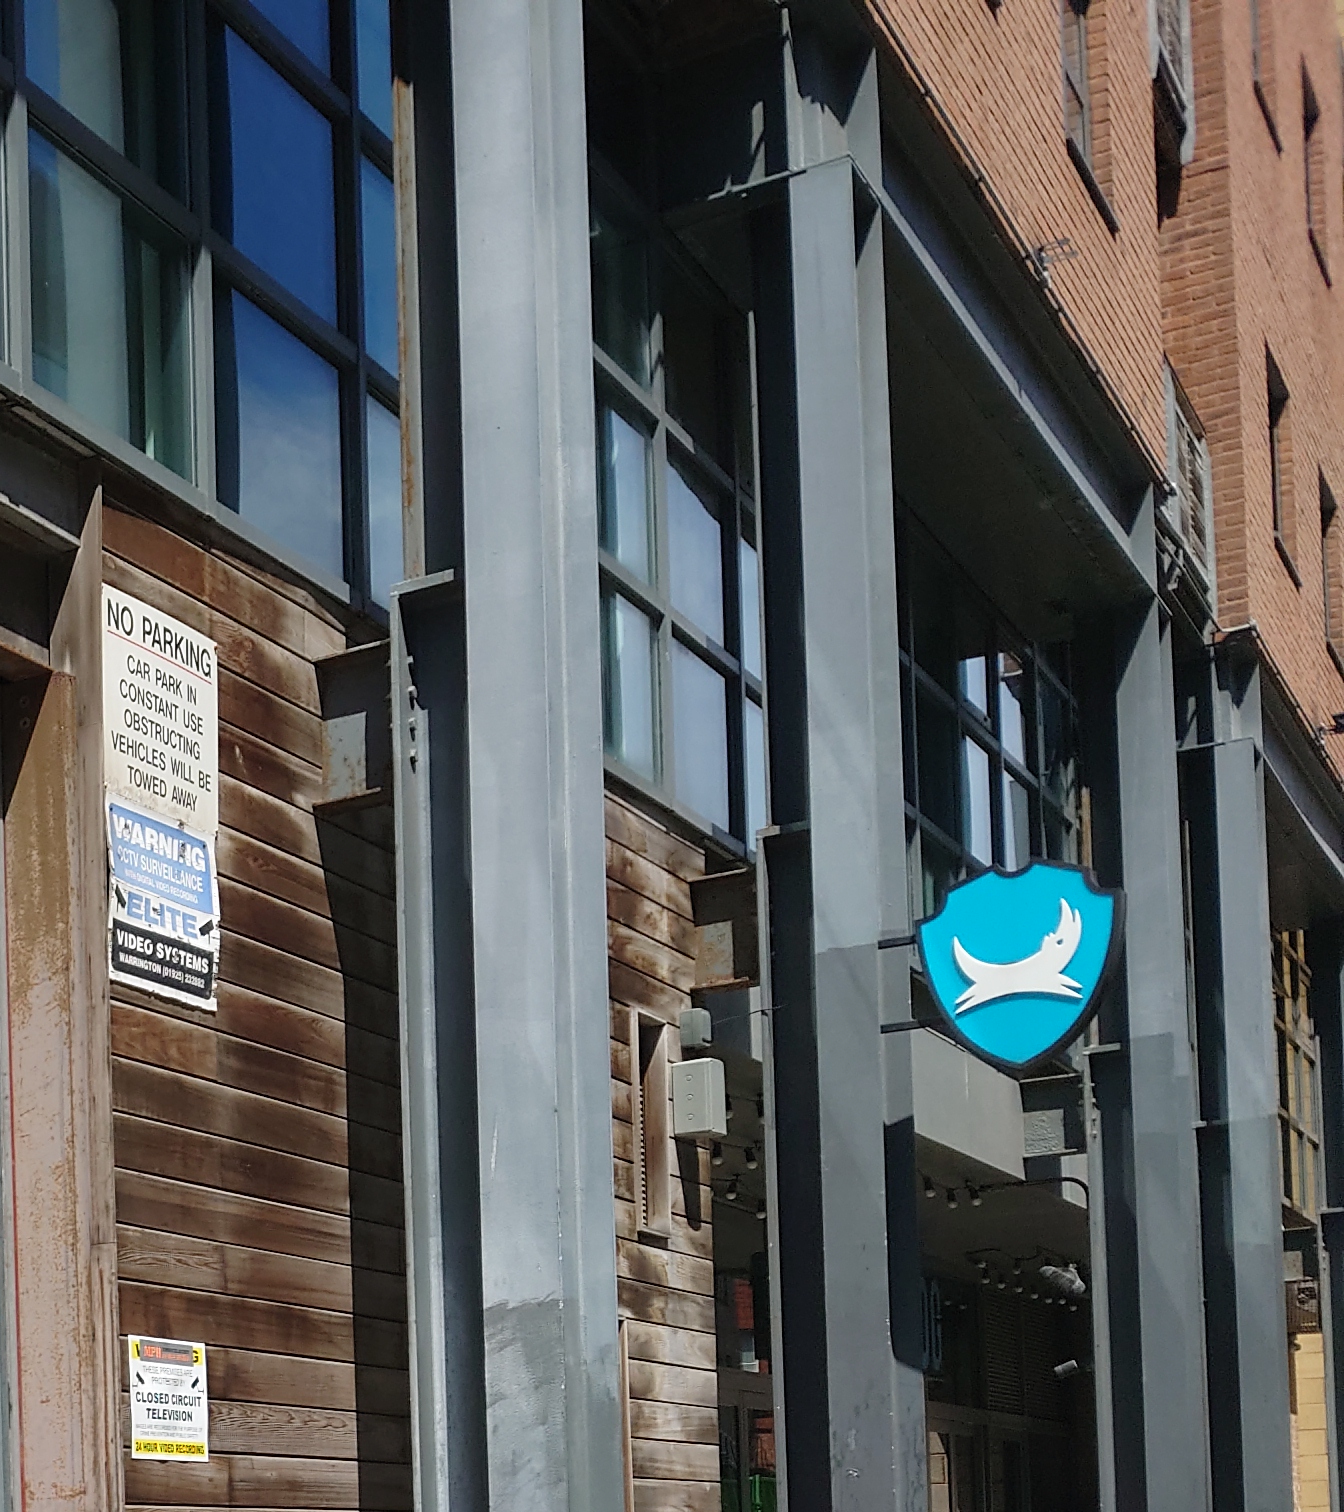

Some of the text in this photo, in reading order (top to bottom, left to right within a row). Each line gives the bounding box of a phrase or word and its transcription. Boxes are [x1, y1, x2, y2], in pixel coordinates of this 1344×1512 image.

[107, 598, 212, 678] NO PARKING
[127, 654, 197, 706] CAR PARK IN
[119, 679, 203, 736] CONSTANT USE
[123, 708, 200, 761] OBSTRUCTING
[111, 730, 211, 792] VEHICLES WILL BE
[127, 765, 198, 813] TOWED AWAY
[112, 813, 206, 872] WARNING
[117, 845, 204, 892] CCTV SURVEILLANCE
[155, 880, 170, 893] VIDEO
[126, 891, 198, 939] ELITE
[117, 929, 209, 974] VIDEO SYSTEMS
[119, 952, 162, 975] WARRINGTON
[135, 1391, 202, 1408] CLOSED CIRCUIT
[146, 1408, 193, 1422] TELEVISION
[159, 1443, 174, 1454] VIDEO
[176, 1444, 204, 1455] RECORDING
